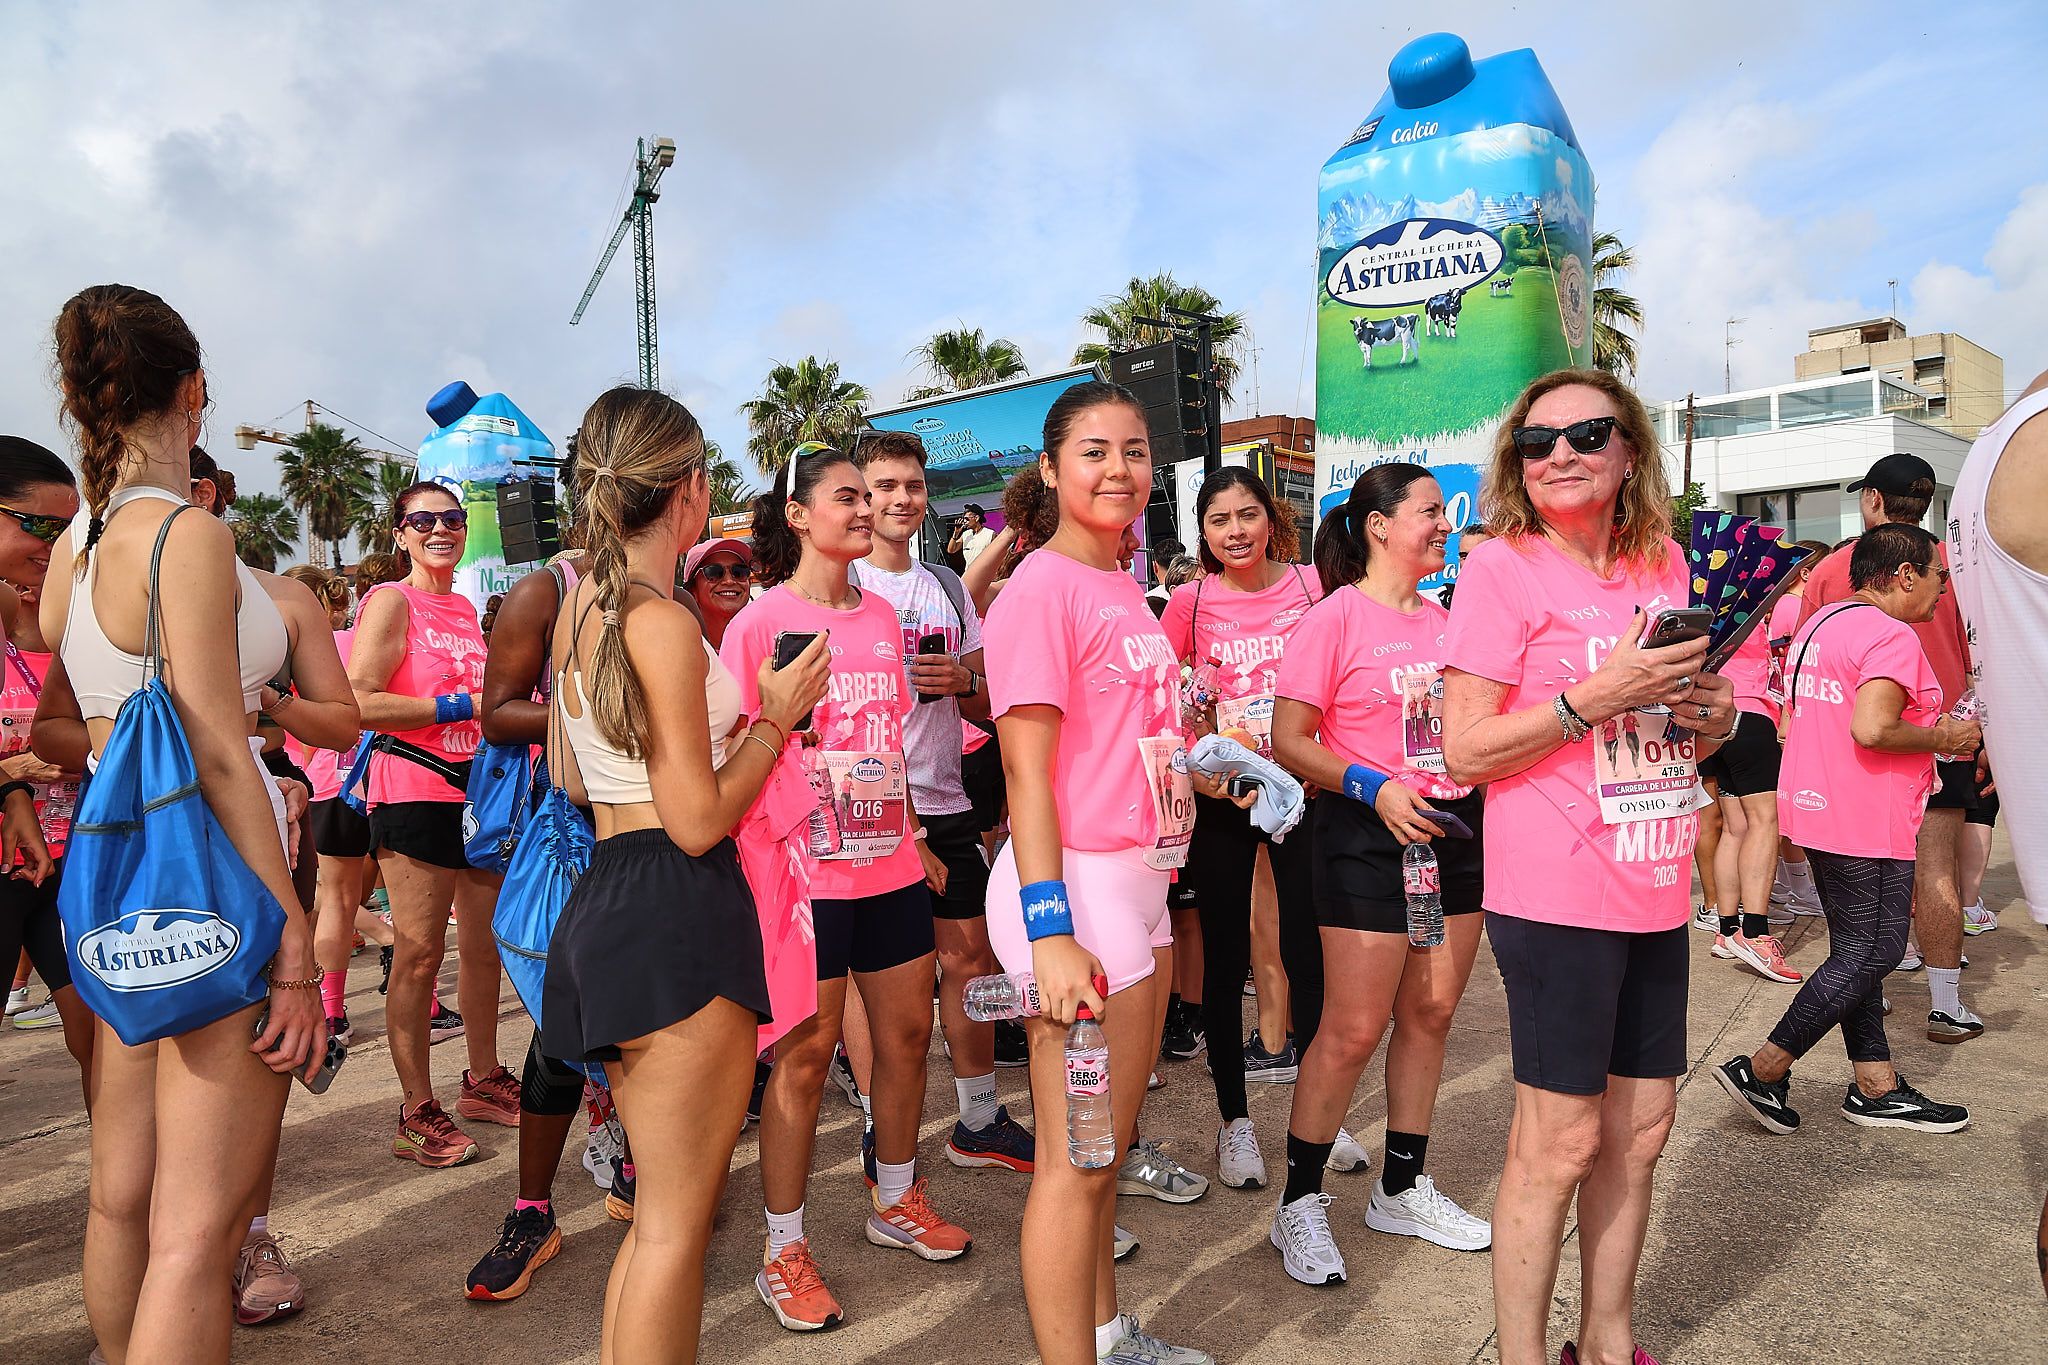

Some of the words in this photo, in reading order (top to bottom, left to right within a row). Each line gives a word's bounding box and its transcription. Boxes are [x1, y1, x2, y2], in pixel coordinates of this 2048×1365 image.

[1361, 248, 1417, 265] CENTRAL
[1421, 239, 1483, 255] LECHERA
[1334, 251, 1489, 295] ASTURIANA
[927, 440, 986, 465] UALQUIERA
[1328, 459, 1366, 490] Leche
[1408, 449, 1428, 465] en
[1202, 620, 1240, 632] OYSHO
[1211, 634, 1290, 666] CARRER
[1373, 640, 1413, 657] OYSHO
[1644, 737, 1694, 764] 016
[1661, 765, 1685, 778] 4796
[1615, 783, 1648, 794] CARRERA
[1650, 781, 1660, 791] DE
[1660, 780, 1670, 790] LA
[1671, 778, 1691, 789] MUJER
[852, 800, 883, 819] 016
[1619, 798, 1666, 814] OYSHO
[841, 843, 860, 853] SHO
[1615, 815, 1698, 863] MUJER
[1653, 864, 1679, 888] 2026
[161, 924, 219, 943] LECHERA
[90, 934, 231, 972] ASTURIANA
[1028, 982, 1039, 1011] SODIO
[1070, 1070, 1098, 1079] ZERO
[1070, 1078, 1098, 1087] SODIO
[405, 1127, 426, 1147] HOKA
